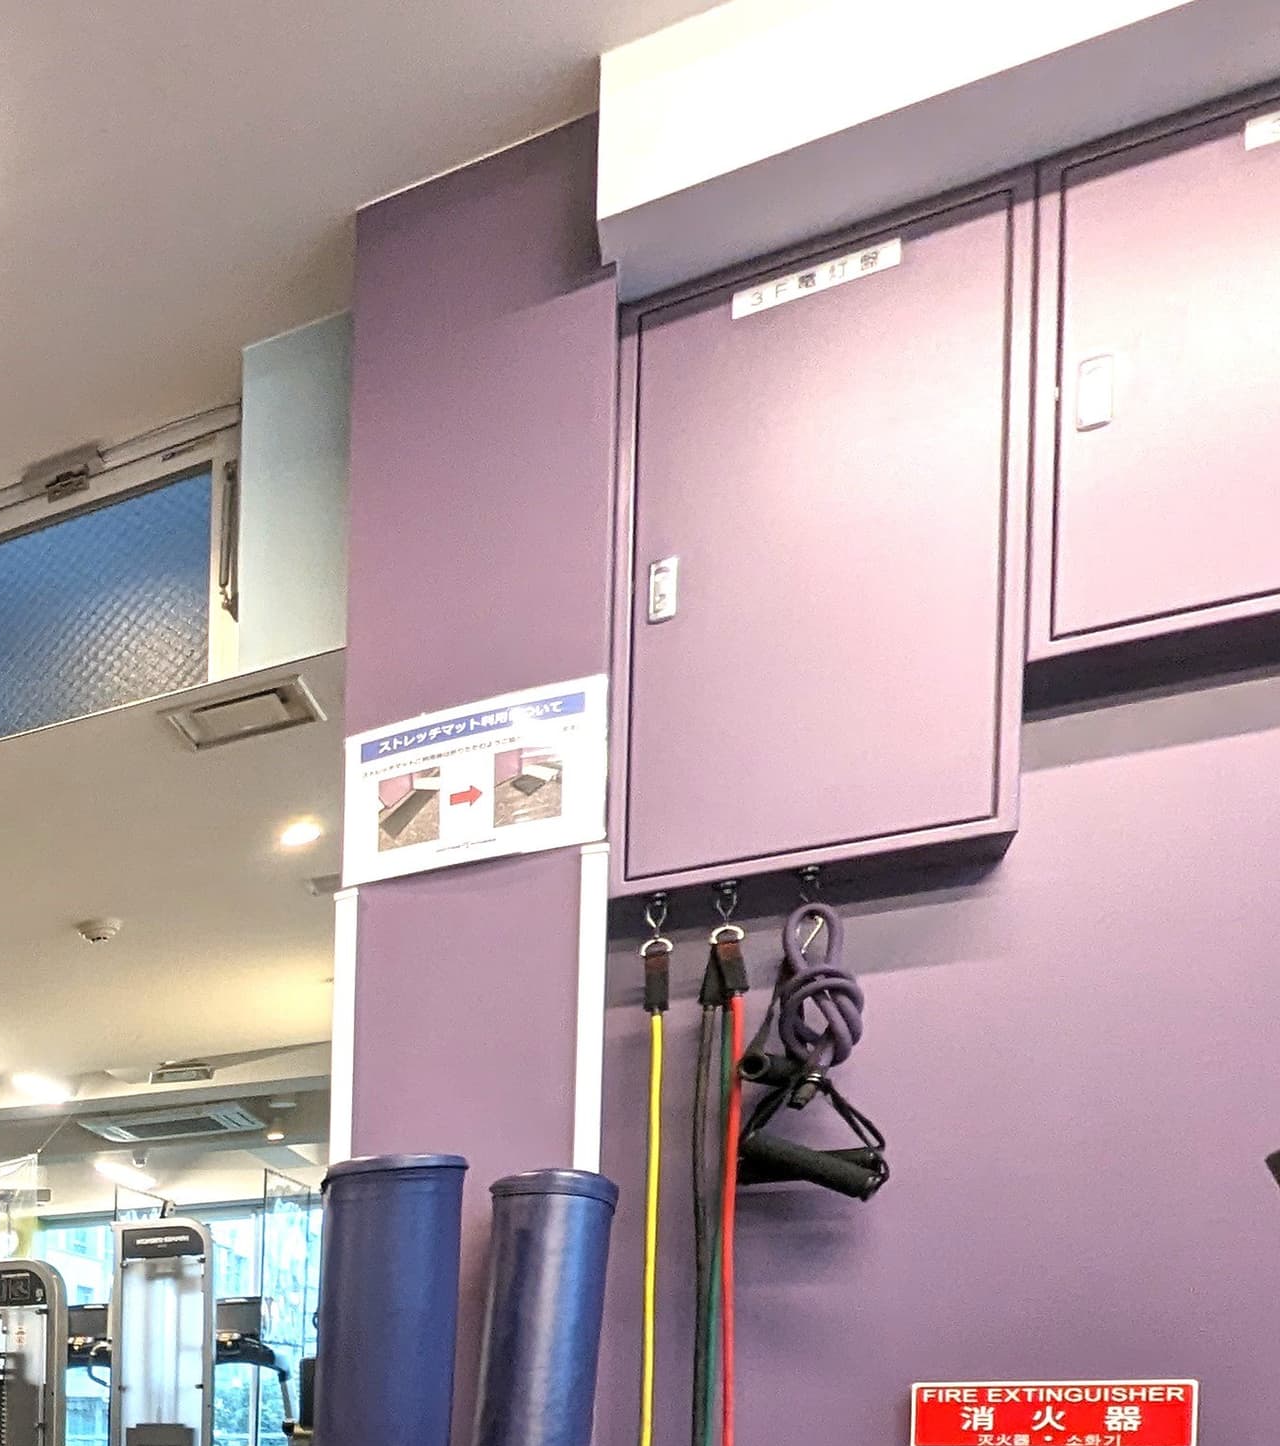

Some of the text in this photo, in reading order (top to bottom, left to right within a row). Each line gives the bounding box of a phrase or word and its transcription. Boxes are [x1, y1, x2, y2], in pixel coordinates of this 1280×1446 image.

[922, 1386, 1185, 1403] FIRE EXTINGUISHER
[960, 1405, 1142, 1431] 消火器
